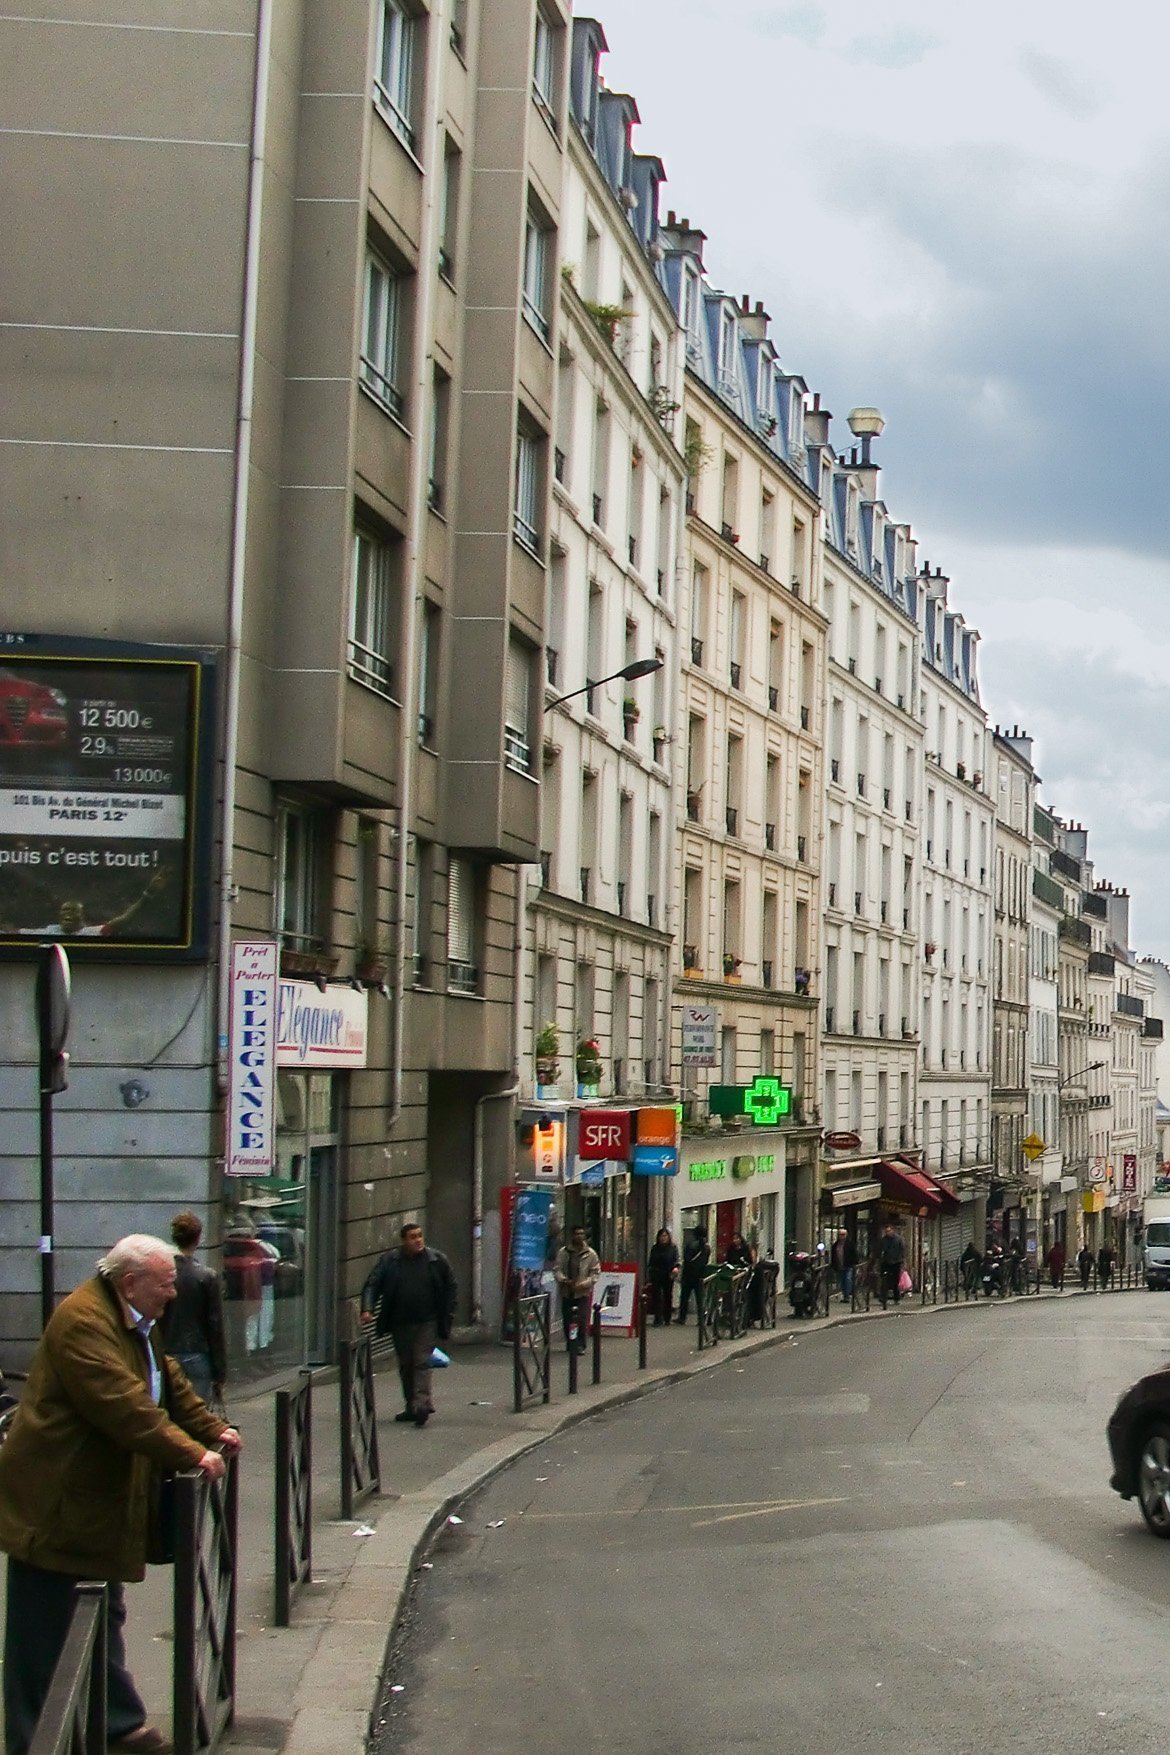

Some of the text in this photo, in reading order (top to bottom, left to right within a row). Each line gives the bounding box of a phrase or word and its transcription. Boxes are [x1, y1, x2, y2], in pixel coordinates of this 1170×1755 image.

[0, 633, 25, 644] BS
[79, 708, 100, 728] 12
[32, 795, 46, 806] Bis
[76, 796, 109, 809] Général
[111, 798, 140, 810] Michel
[49, 809, 99, 821] PARIS
[48, 848, 100, 866] c'est
[235, 970, 275, 981] Porter
[239, 990, 267, 1149] ELEGANCE
[585, 1125, 621, 1147] SFR
